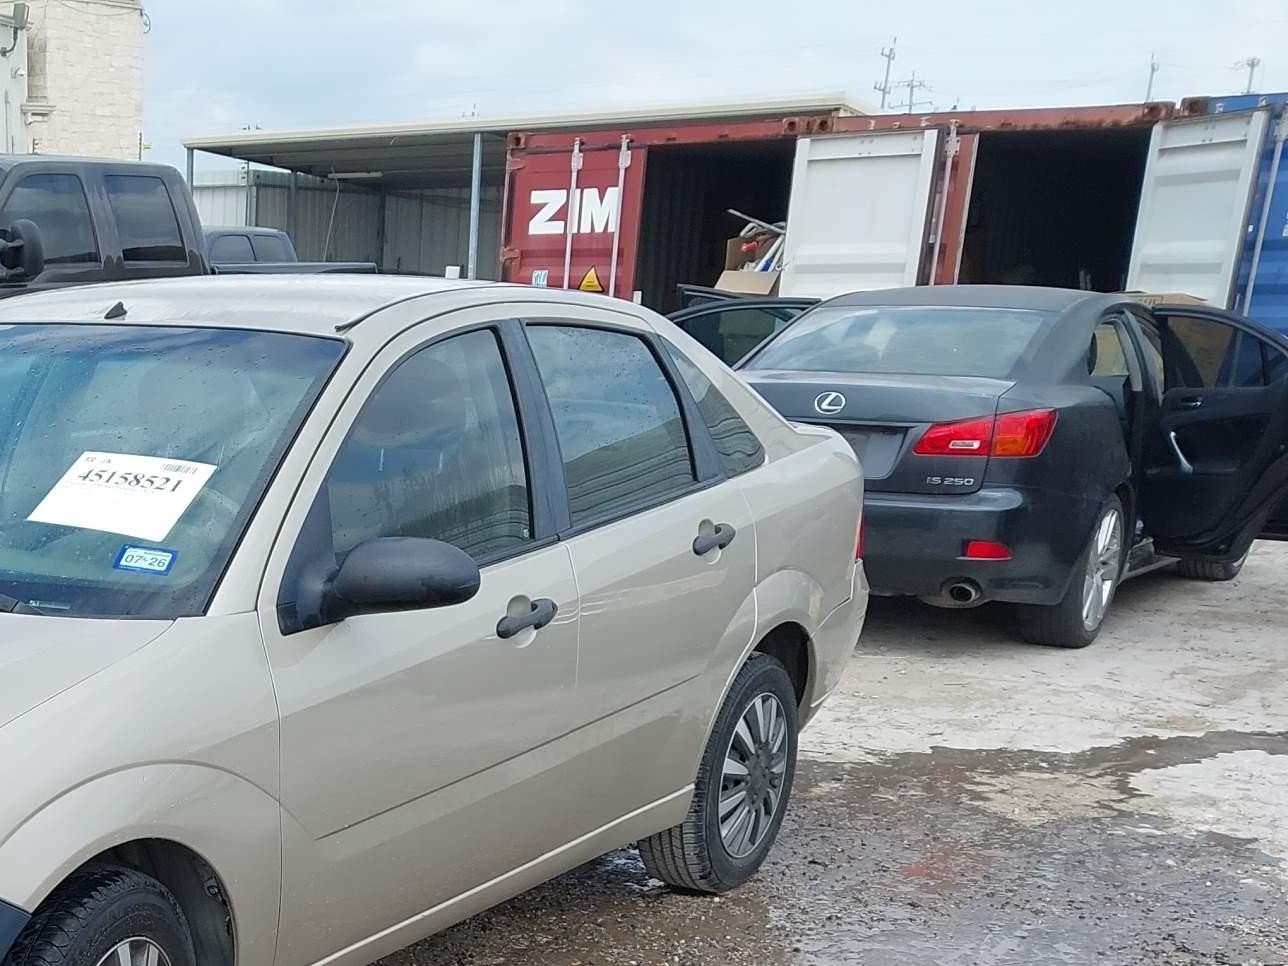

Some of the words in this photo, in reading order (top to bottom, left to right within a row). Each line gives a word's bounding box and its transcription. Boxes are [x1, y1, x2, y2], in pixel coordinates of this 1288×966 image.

[528, 187, 620, 235] ZIM
[77, 469, 183, 493] 45158521
[927, 476, 942, 485] IS
[943, 477, 975, 486] 250
